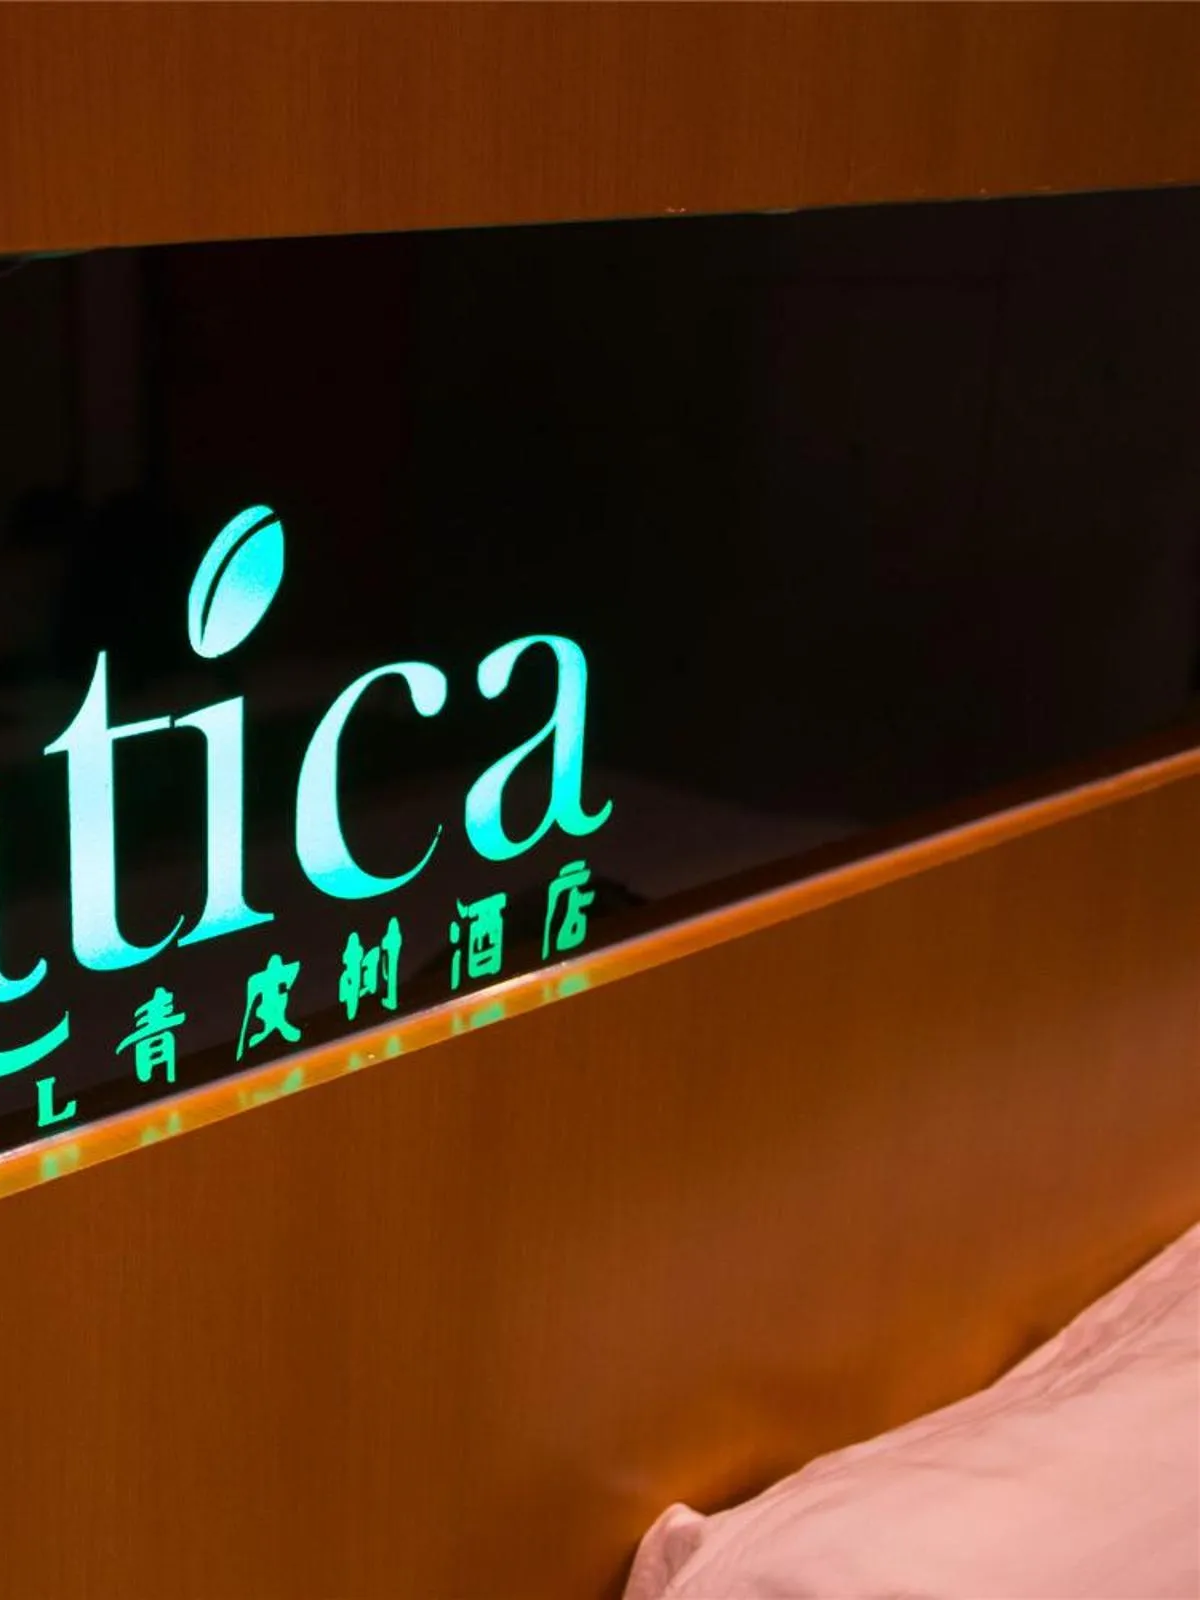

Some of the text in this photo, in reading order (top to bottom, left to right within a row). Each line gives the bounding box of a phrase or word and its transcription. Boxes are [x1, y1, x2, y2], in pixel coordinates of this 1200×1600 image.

[117, 861, 596, 1083] 青皮树酒店
